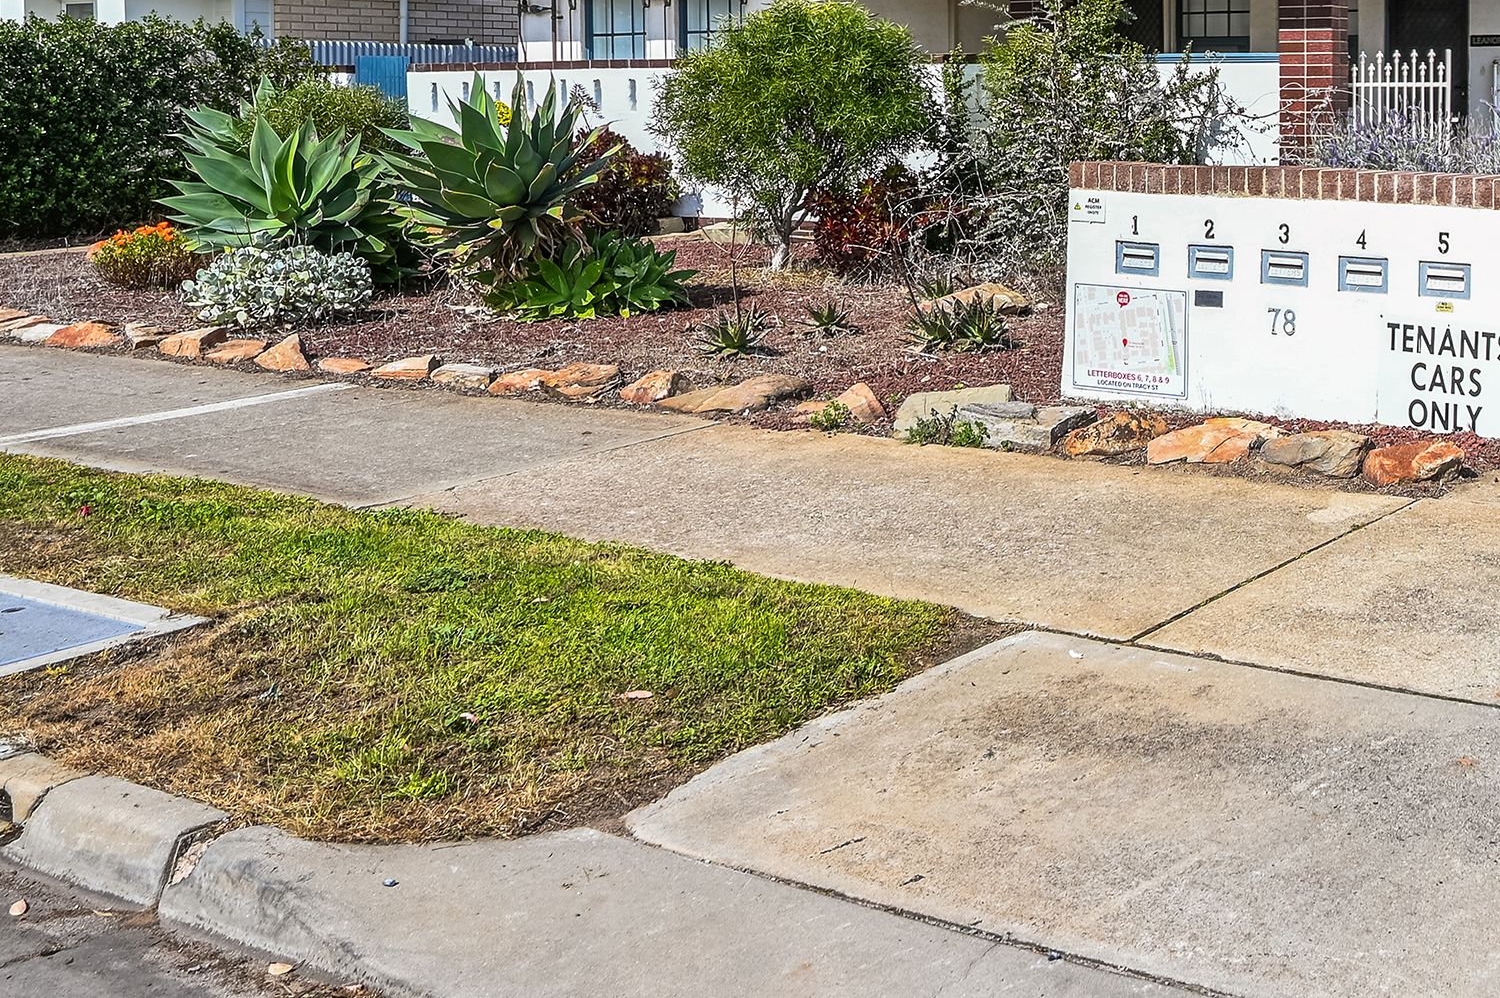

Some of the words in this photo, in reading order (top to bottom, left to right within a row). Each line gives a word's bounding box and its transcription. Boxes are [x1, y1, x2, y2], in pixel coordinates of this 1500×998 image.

[1132, 215, 1139, 235] 1
[1204, 219, 1215, 239] 2
[1278, 223, 1290, 244] 3
[1356, 229, 1367, 250] 4
[1438, 232, 1450, 254] 5
[1267, 307, 1296, 336] 78
[1087, 369, 1136, 381] LETTERBOXES
[1152, 375, 1157, 383] 8
[1164, 376, 1170, 384] 9
[1097, 379, 1122, 387] LOCATED
[1132, 382, 1151, 390] TRACY
[1411, 362, 1482, 397] CARS
[1408, 398, 1483, 433] ONLY
